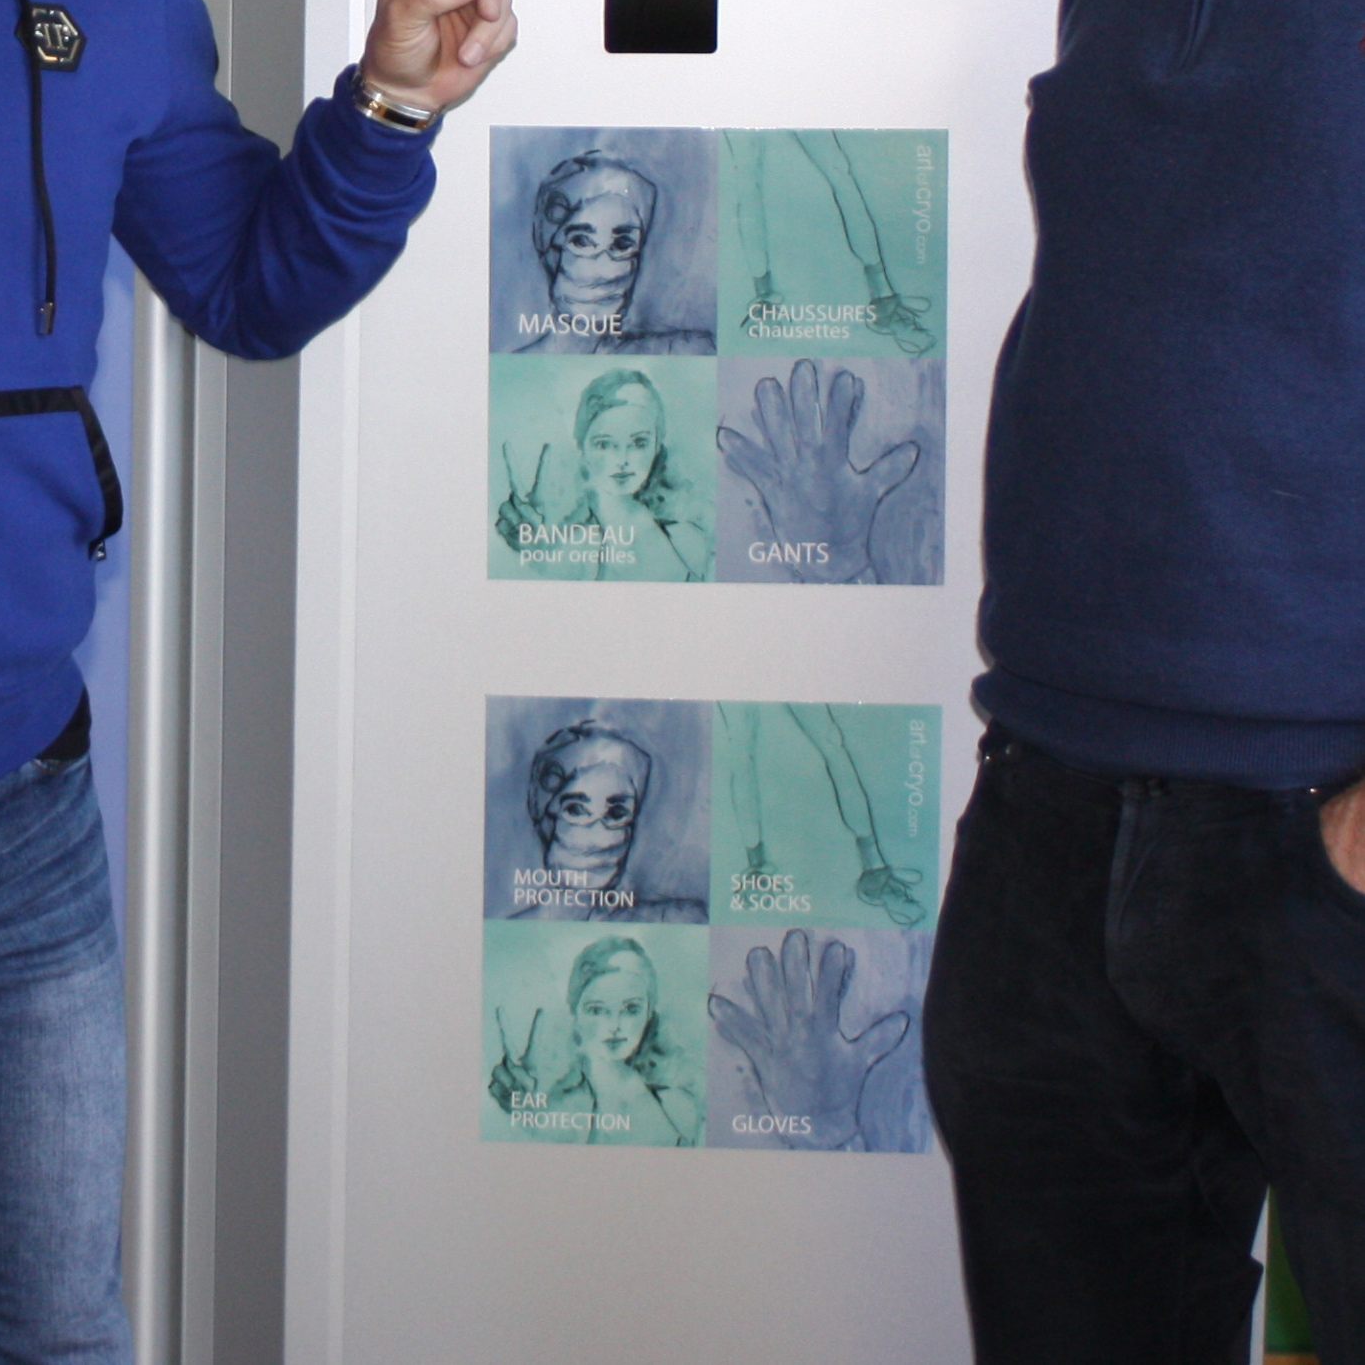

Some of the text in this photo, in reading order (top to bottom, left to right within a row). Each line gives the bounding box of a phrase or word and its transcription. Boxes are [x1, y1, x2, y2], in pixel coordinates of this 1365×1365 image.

[748, 303, 877, 322] CHAUSSURES
[518, 313, 624, 336] MASQUE
[748, 321, 850, 339] chausettes
[518, 523, 635, 546] BANDEAU
[520, 544, 636, 565] pour oreilles
[747, 541, 830, 564] GANTS
[513, 868, 588, 888] MOUTH
[730, 873, 795, 892] SHOES
[513, 888, 635, 907] PROTECTION
[729, 893, 812, 912] & SOCKS
[510, 1091, 548, 1109] EAR
[510, 1111, 632, 1131] PROTECTION
[731, 1114, 812, 1135] GLOVES
